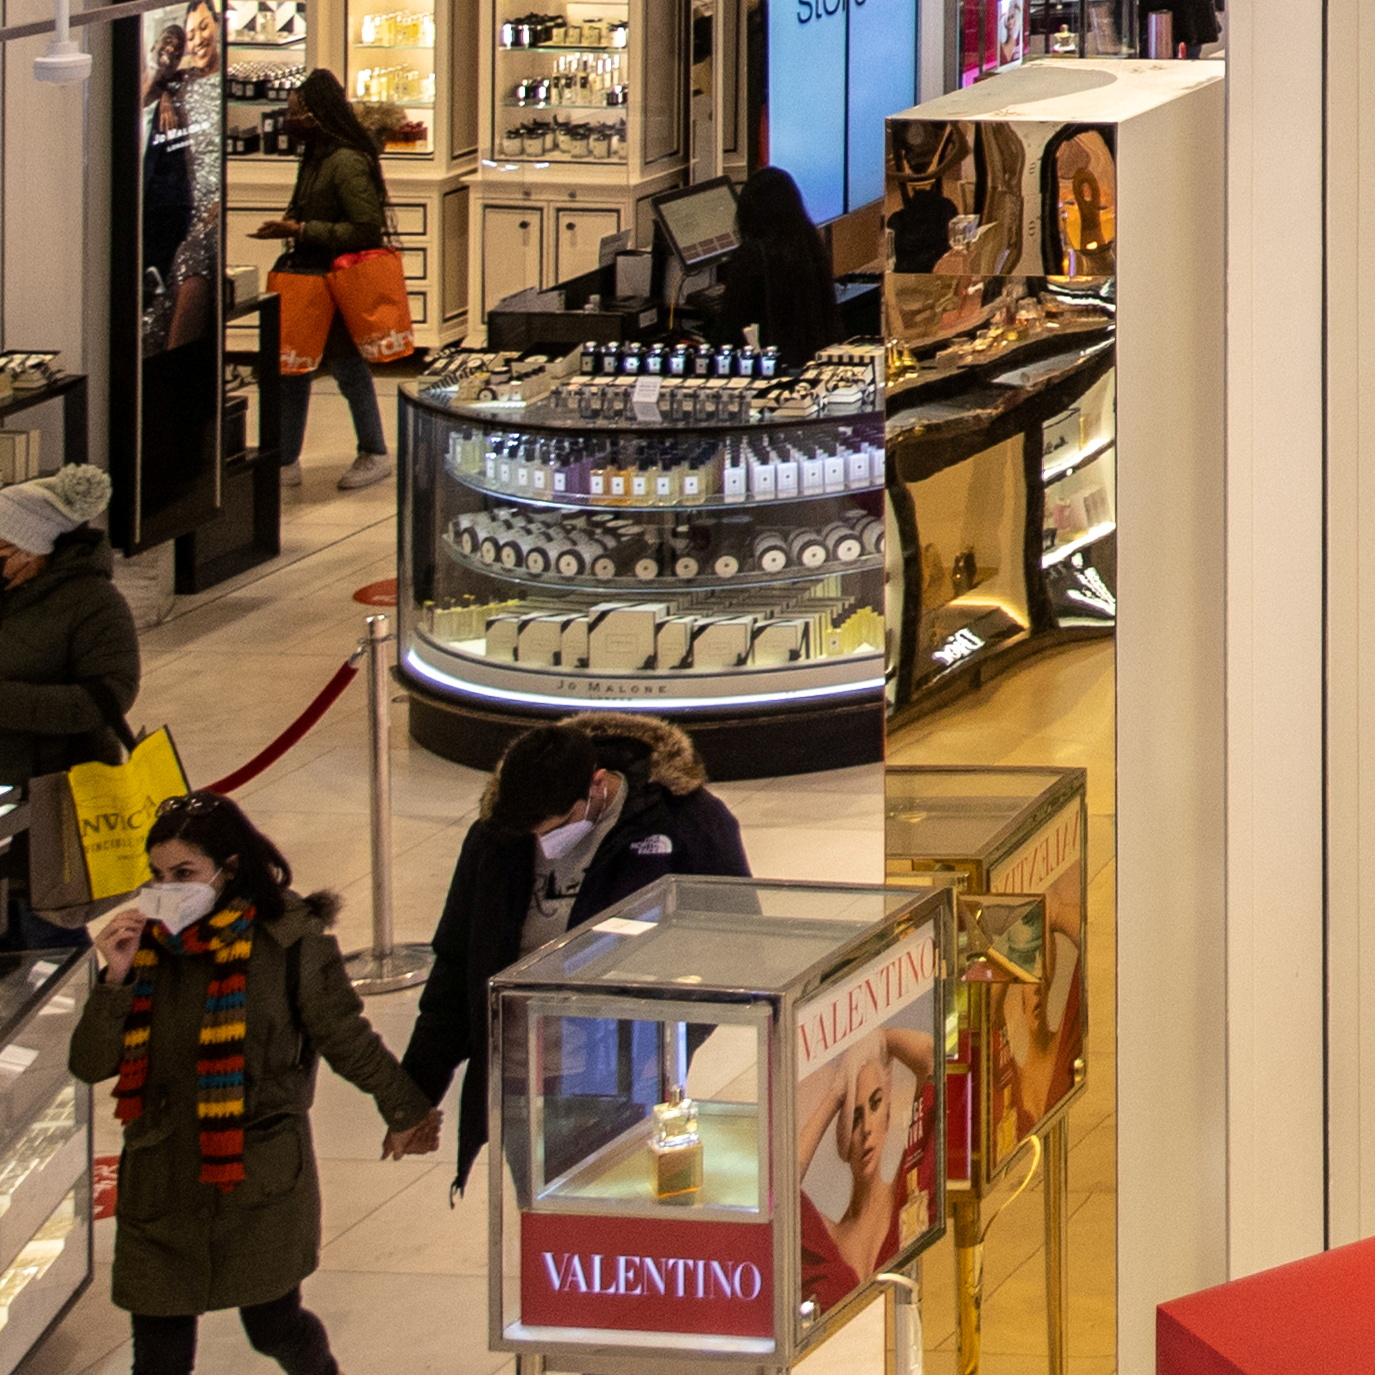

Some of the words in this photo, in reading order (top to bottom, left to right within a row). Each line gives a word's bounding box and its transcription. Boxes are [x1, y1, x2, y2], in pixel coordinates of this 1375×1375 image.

[588, 682, 667, 694] MALONE
[798, 935, 937, 1064] VALENTINO
[542, 1251, 763, 1301] VALENTINO
